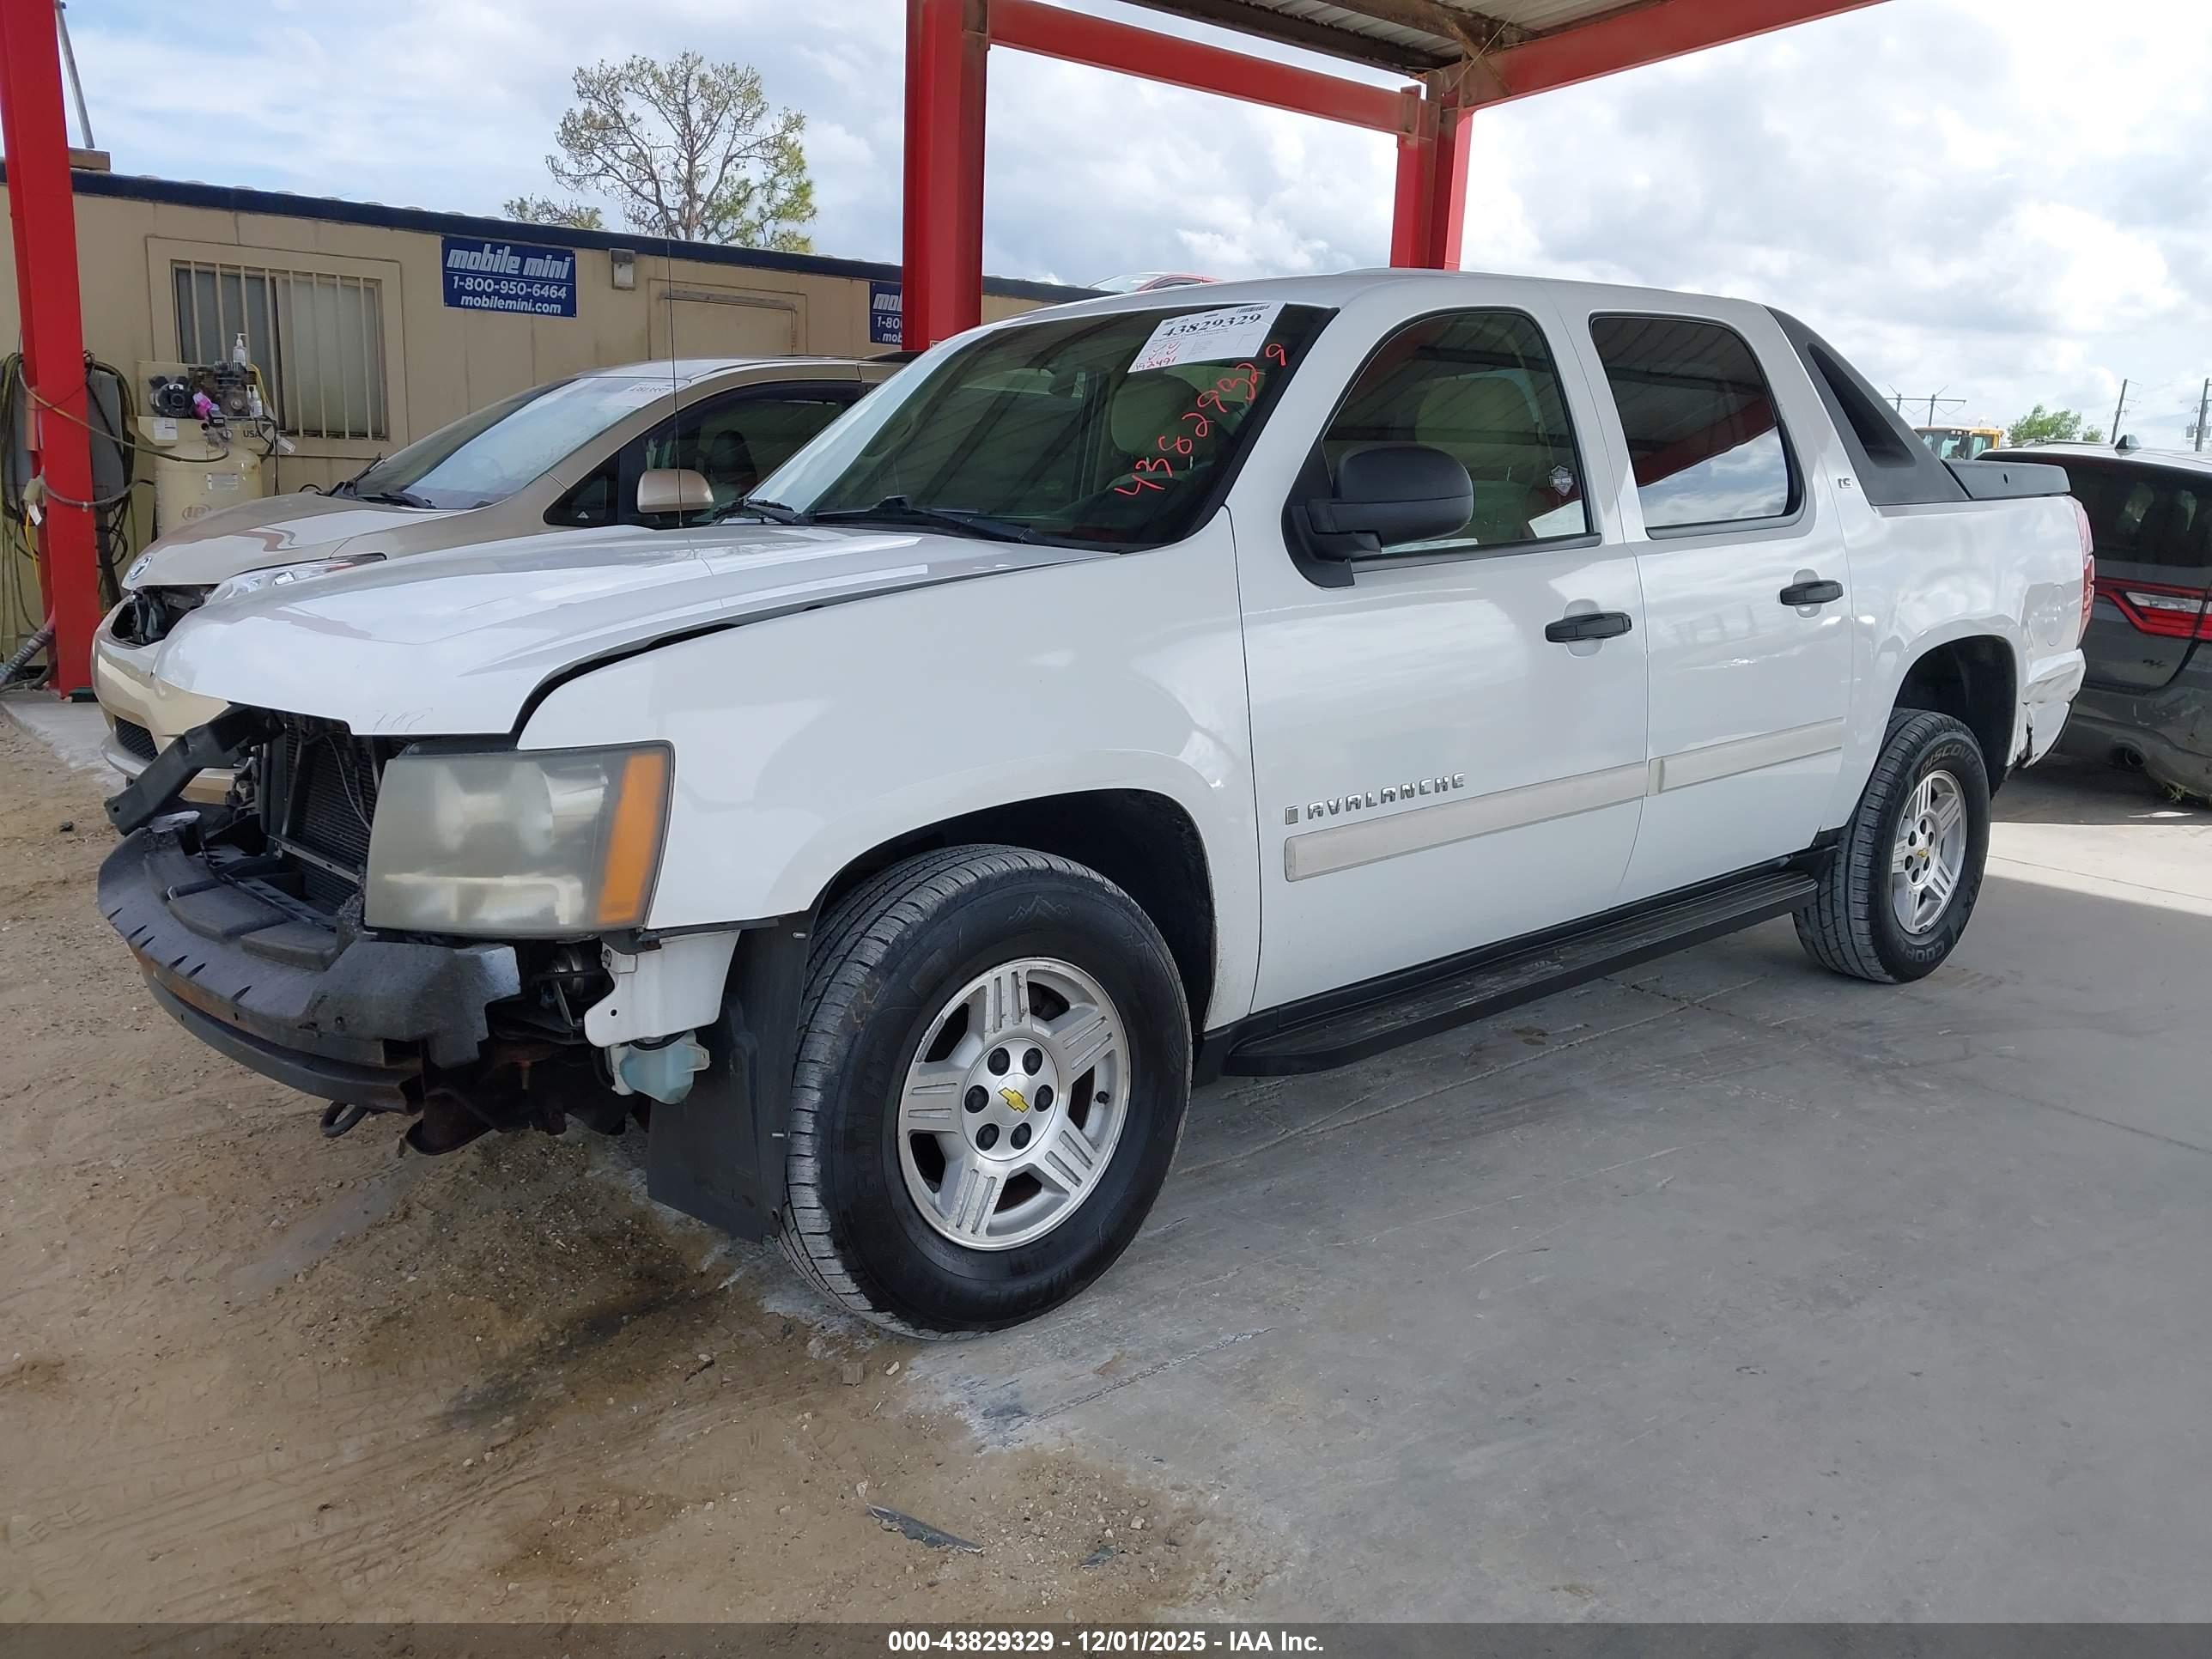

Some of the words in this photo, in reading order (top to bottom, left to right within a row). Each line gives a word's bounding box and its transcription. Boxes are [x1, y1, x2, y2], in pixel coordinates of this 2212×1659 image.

[446, 243, 520, 275] mobile
[523, 255, 571, 279] mini
[453, 276, 567, 299] 1-800-950-6464
[460, 295, 561, 313] mobilemini.com
[877, 315, 902, 329] 1-80
[1162, 313, 1262, 337] 43829329
[1308, 773, 1466, 819] AVALANCHE
